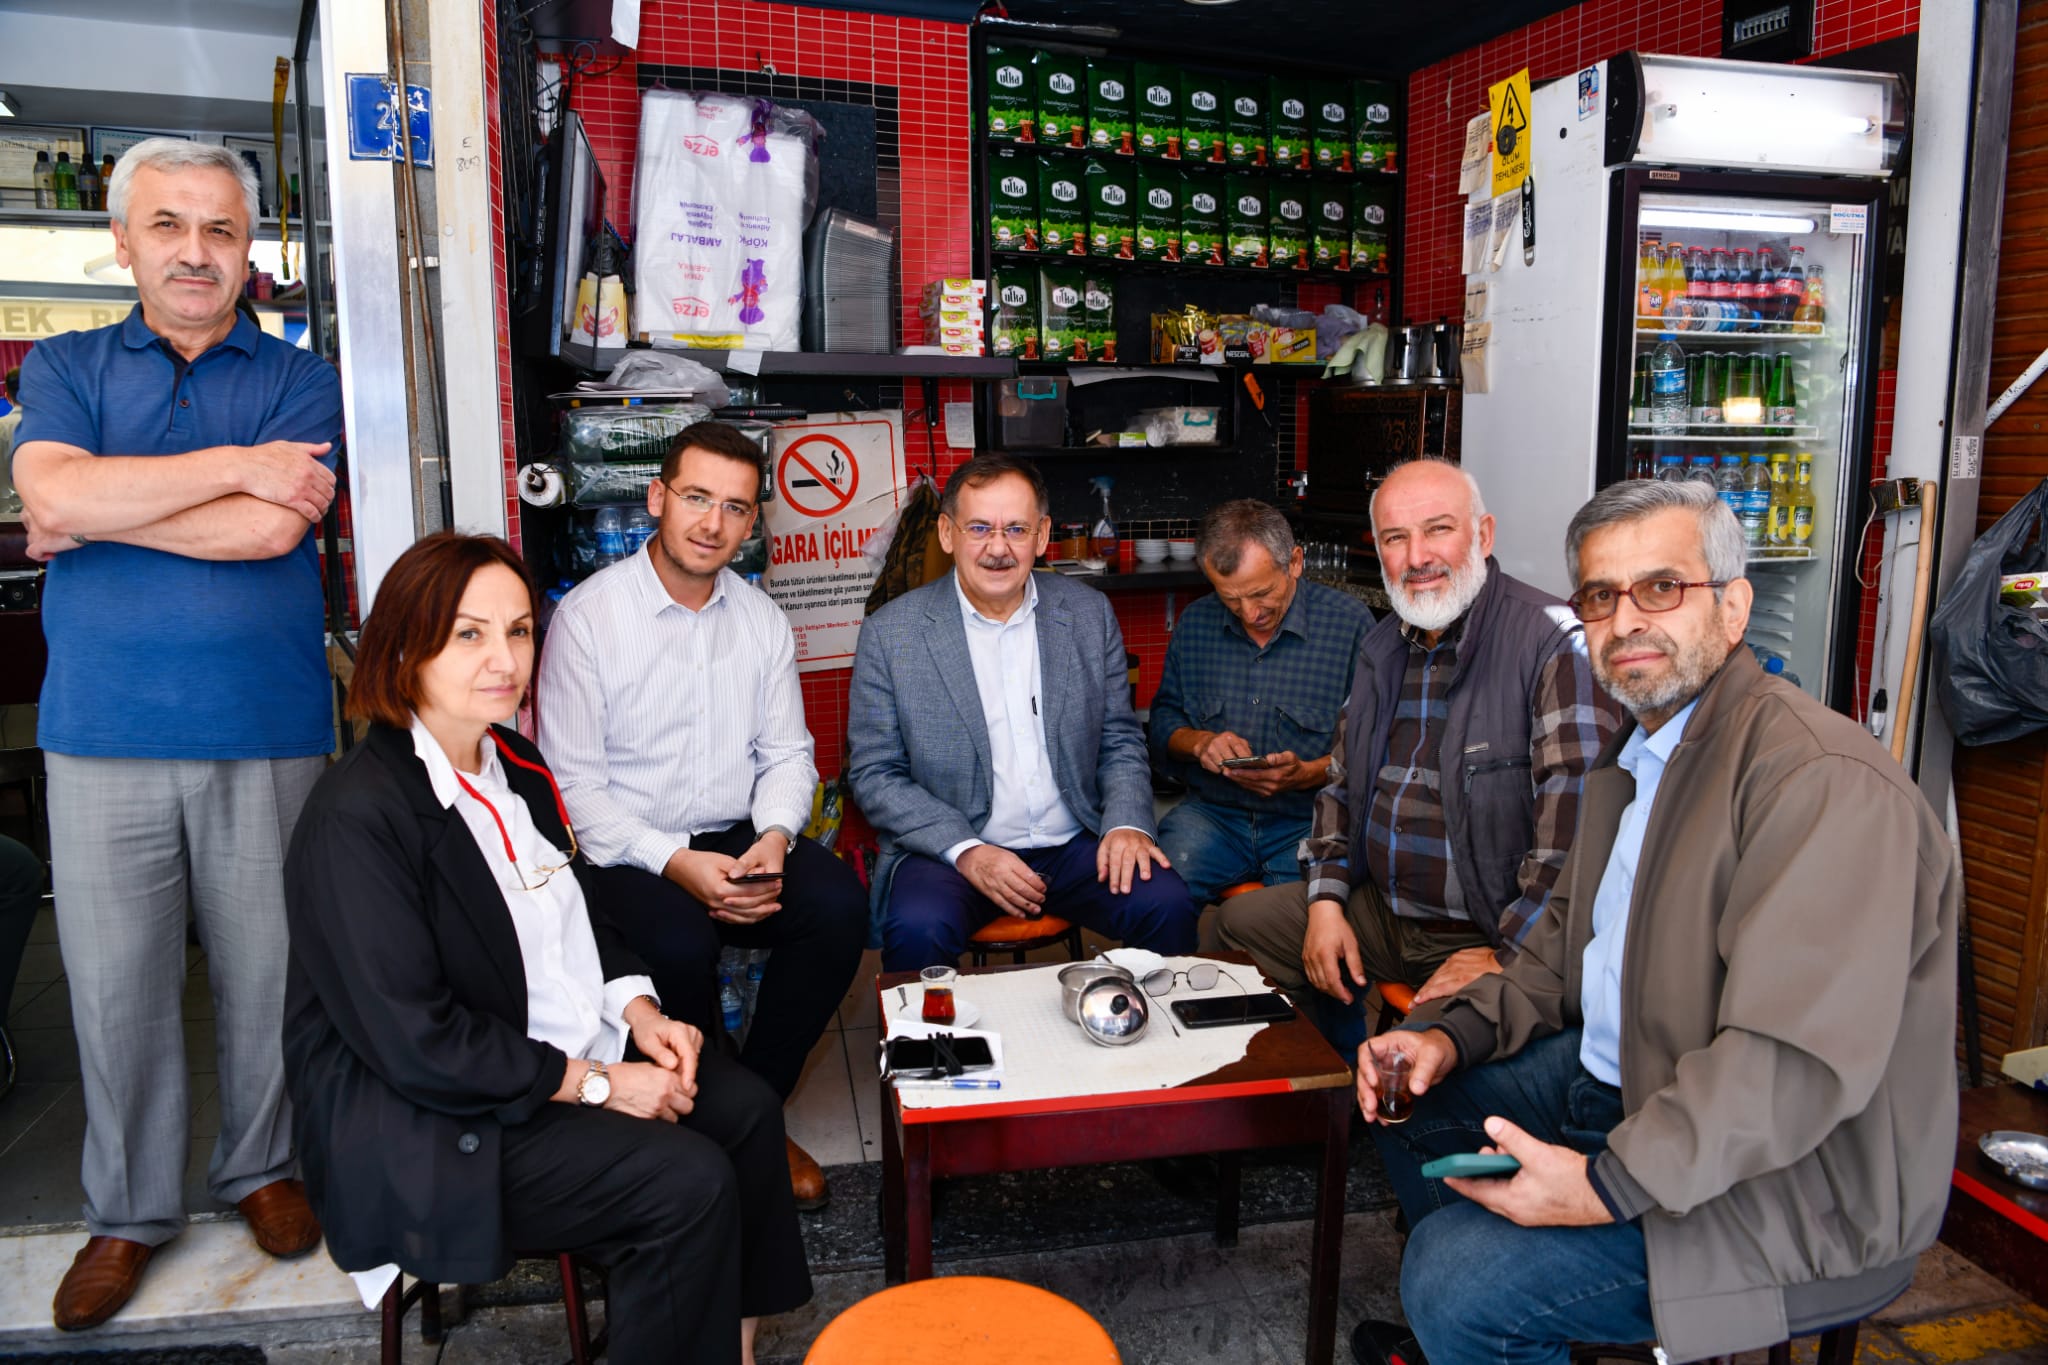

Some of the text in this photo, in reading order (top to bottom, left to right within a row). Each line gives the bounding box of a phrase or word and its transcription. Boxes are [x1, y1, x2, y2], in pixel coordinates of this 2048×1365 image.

[671, 232, 722, 247] AMBALAJ
[771, 522, 879, 569] GARA İÇİLM
[770, 570, 873, 588] Burada tütün ürünleri tüketilmesi yasak
[797, 587, 833, 597] tüketilmesine
[833, 585, 843, 596] göz
[844, 584, 862, 595] yuman
[785, 602, 803, 611] Kanun
[828, 598, 840, 607] idari
[840, 597, 853, 608] para
[853, 596, 867, 604] ceza
